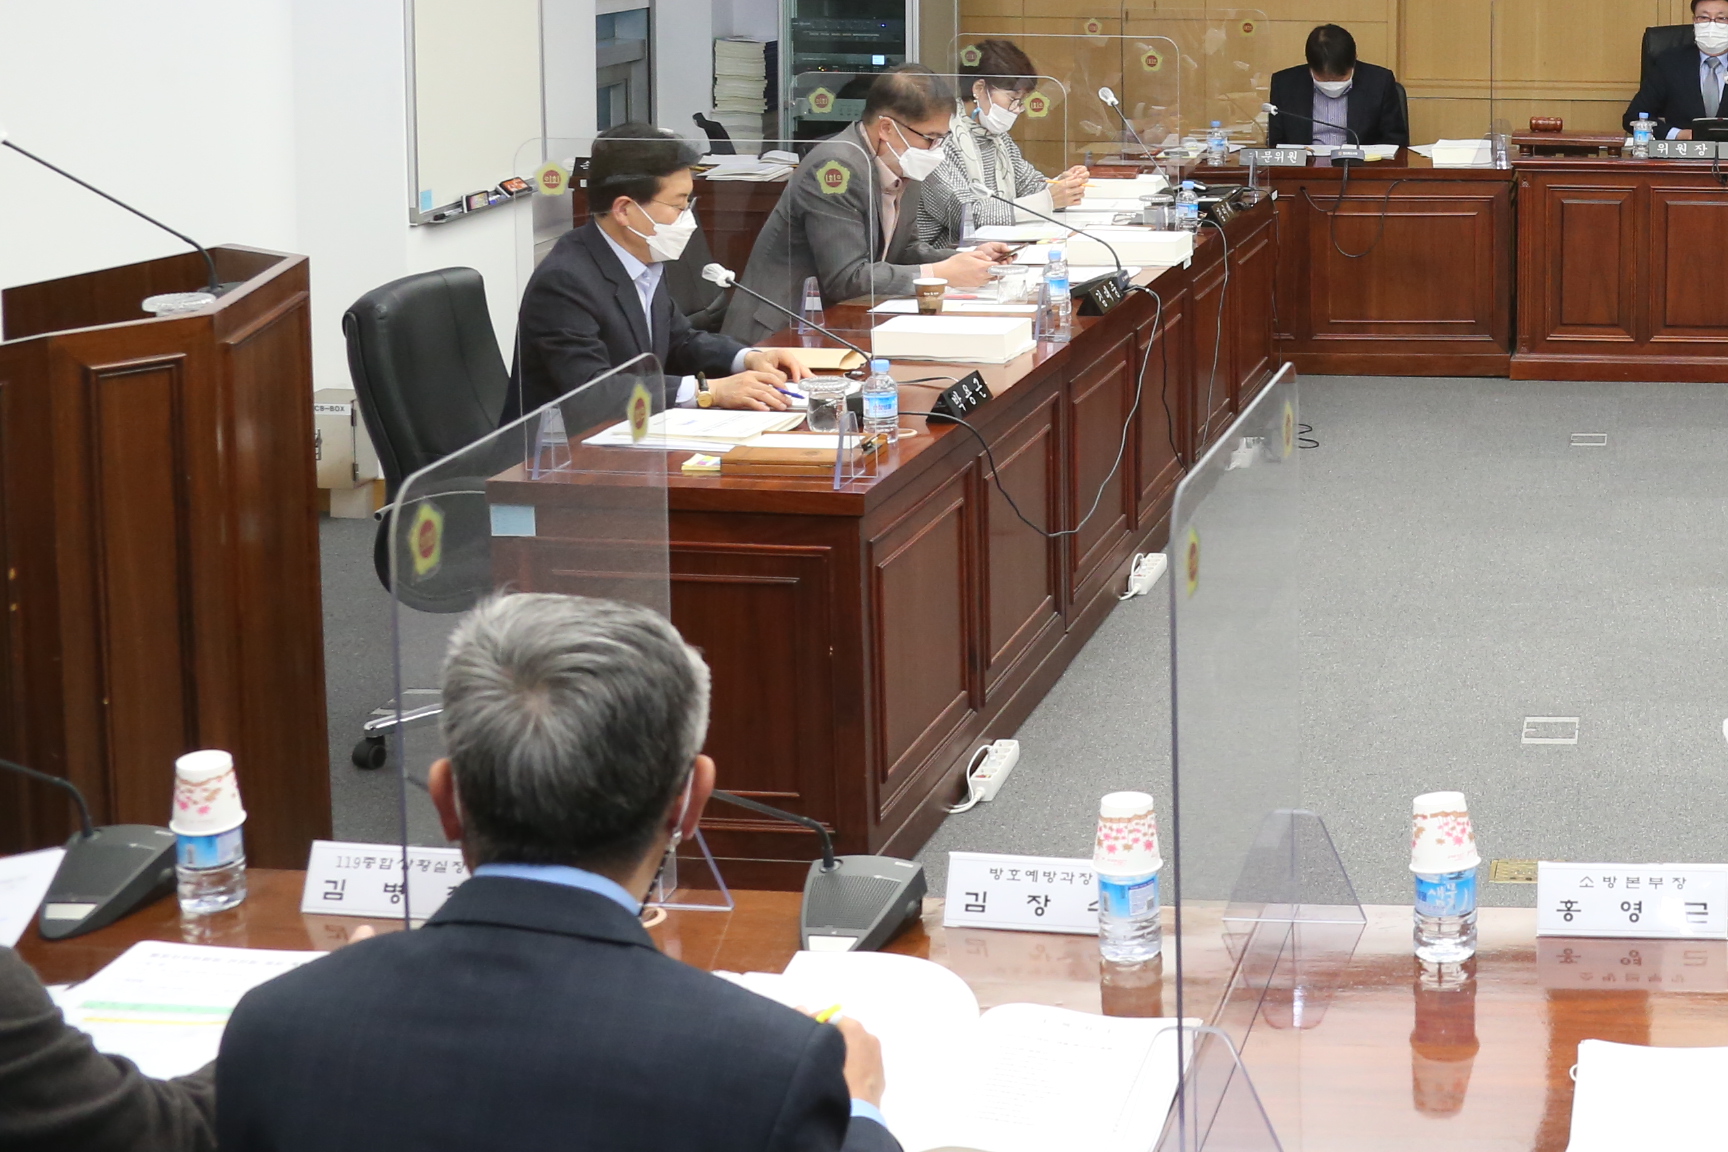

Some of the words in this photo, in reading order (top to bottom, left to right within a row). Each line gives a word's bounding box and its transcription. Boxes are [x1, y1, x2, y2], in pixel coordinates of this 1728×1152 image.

[1656, 142, 1708, 156] 위원장
[989, 867, 1094, 886] 방호예방과장
[1579, 875, 1688, 891] 소방본부장
[1555, 899, 1710, 924] 홍영근
